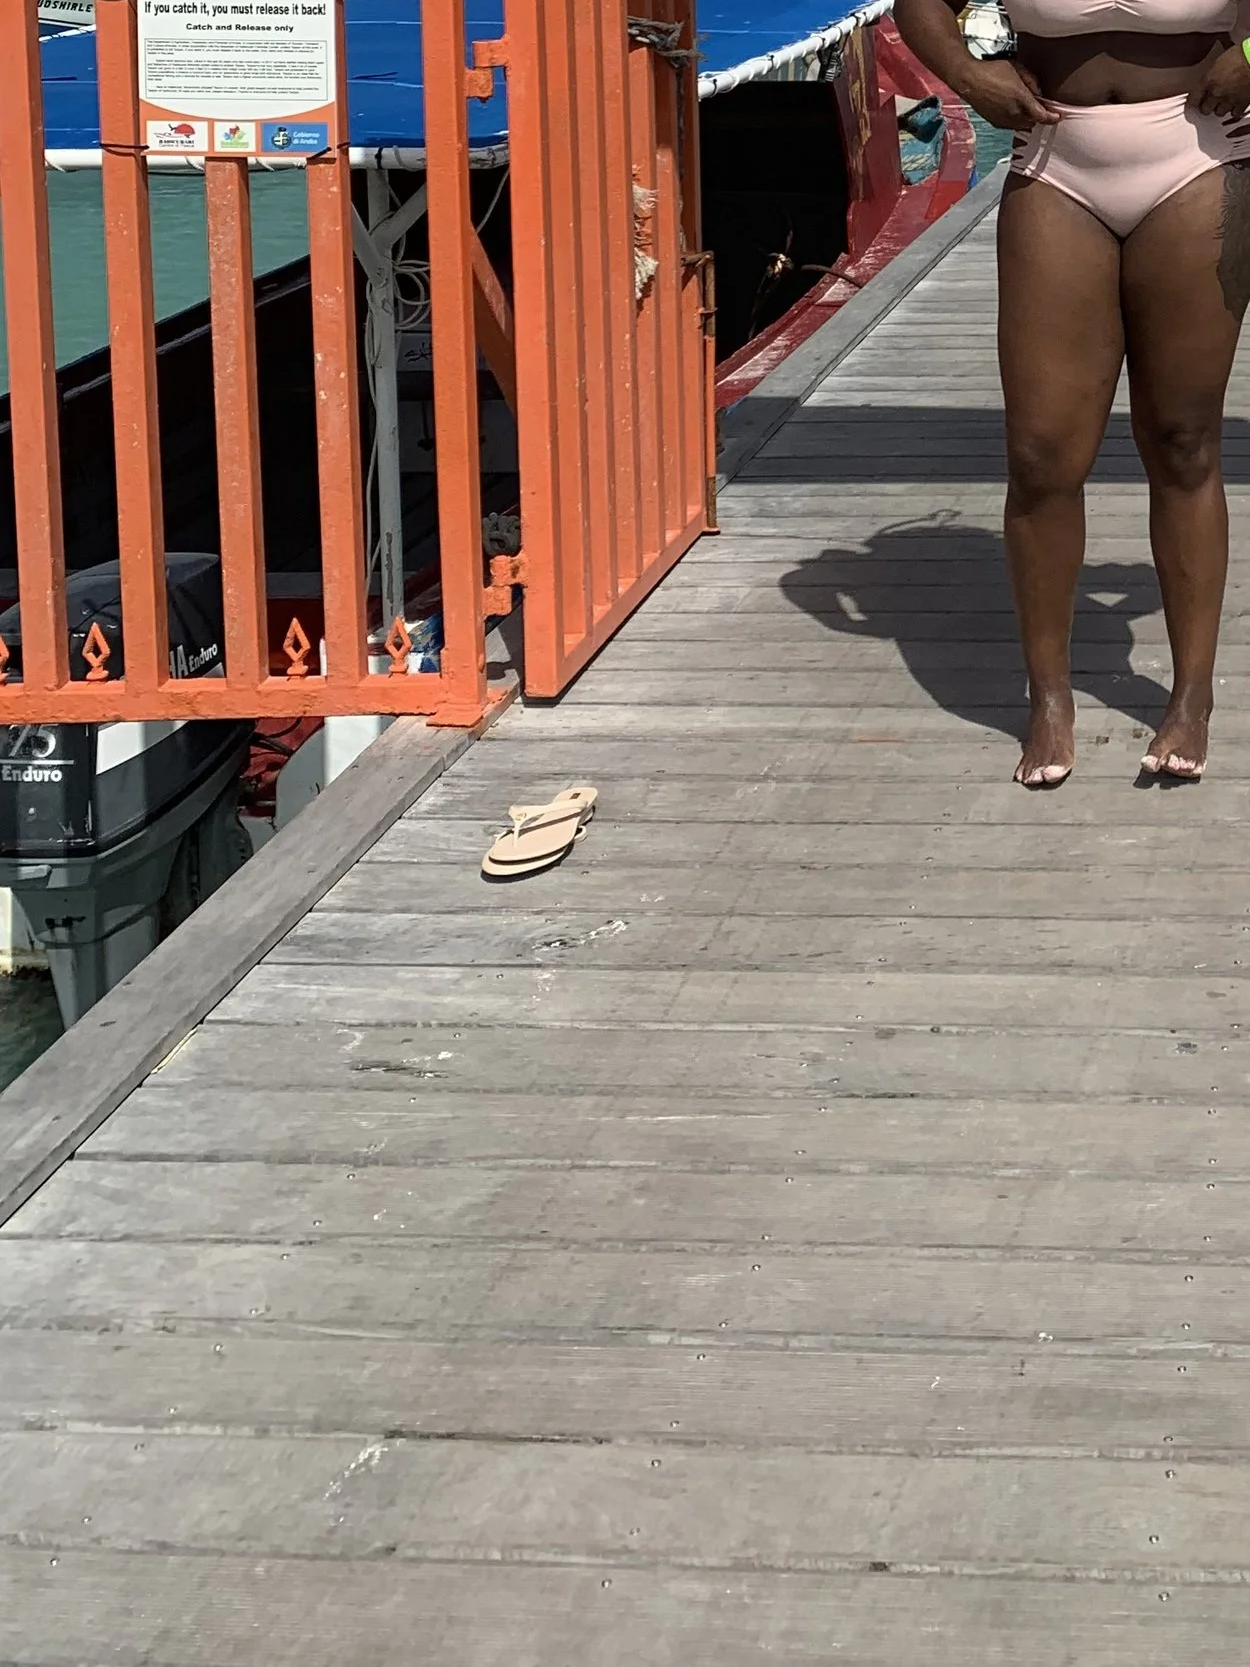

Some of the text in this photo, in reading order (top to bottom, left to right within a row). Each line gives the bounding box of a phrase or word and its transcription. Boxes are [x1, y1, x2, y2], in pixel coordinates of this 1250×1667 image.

[145, 2, 326, 17] If you catch it, you must release it back!
[186, 23, 213, 31] Catch
[274, 24, 294, 32] only
[189, 643, 218, 673] Enduro
[2, 765, 63, 783] Enduro
